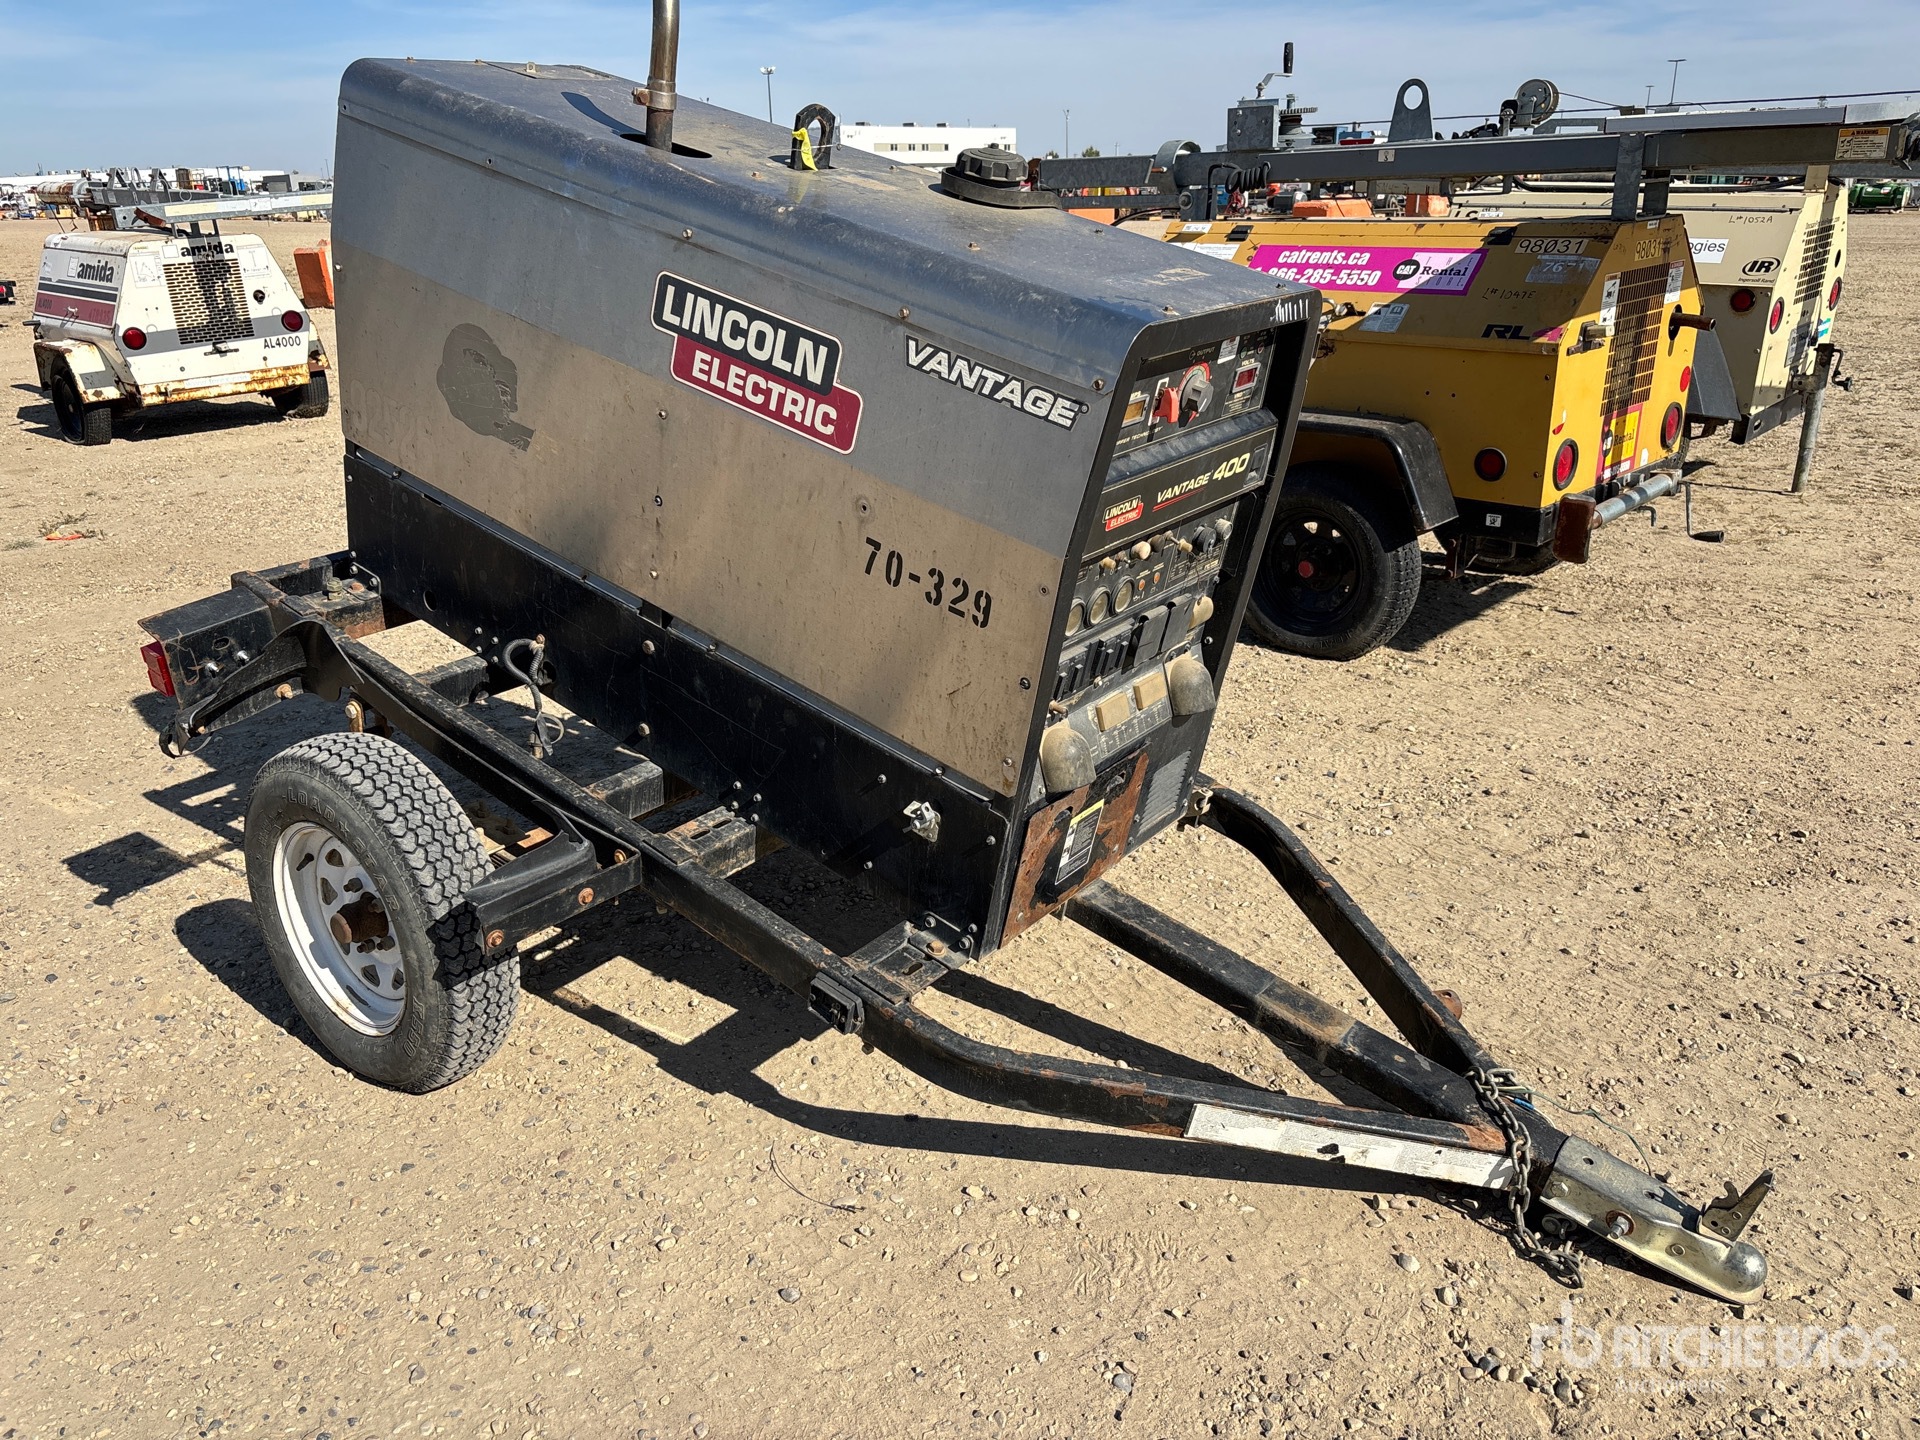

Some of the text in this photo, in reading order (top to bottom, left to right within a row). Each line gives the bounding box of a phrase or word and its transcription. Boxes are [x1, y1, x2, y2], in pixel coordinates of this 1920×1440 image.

[180, 242, 235, 257] amida
[1519, 239, 1584, 253] 98031
[1278, 249, 1371, 265] catrents.ca
[77, 260, 114, 283] amida
[1395, 264, 1468, 277] CAT Rental
[1747, 261, 1775, 273] IR
[263, 336, 301, 349] AL4000
[662, 284, 828, 385] LINCOLN
[692, 349, 838, 436] ELECTRIC
[908, 339, 1080, 428] VANTAGE
[1157, 453, 1251, 503] VANTAGE 400
[1105, 498, 1139, 520] LINCOLN
[1110, 510, 1139, 527] ELECTRIC
[864, 536, 992, 629] 70-329
